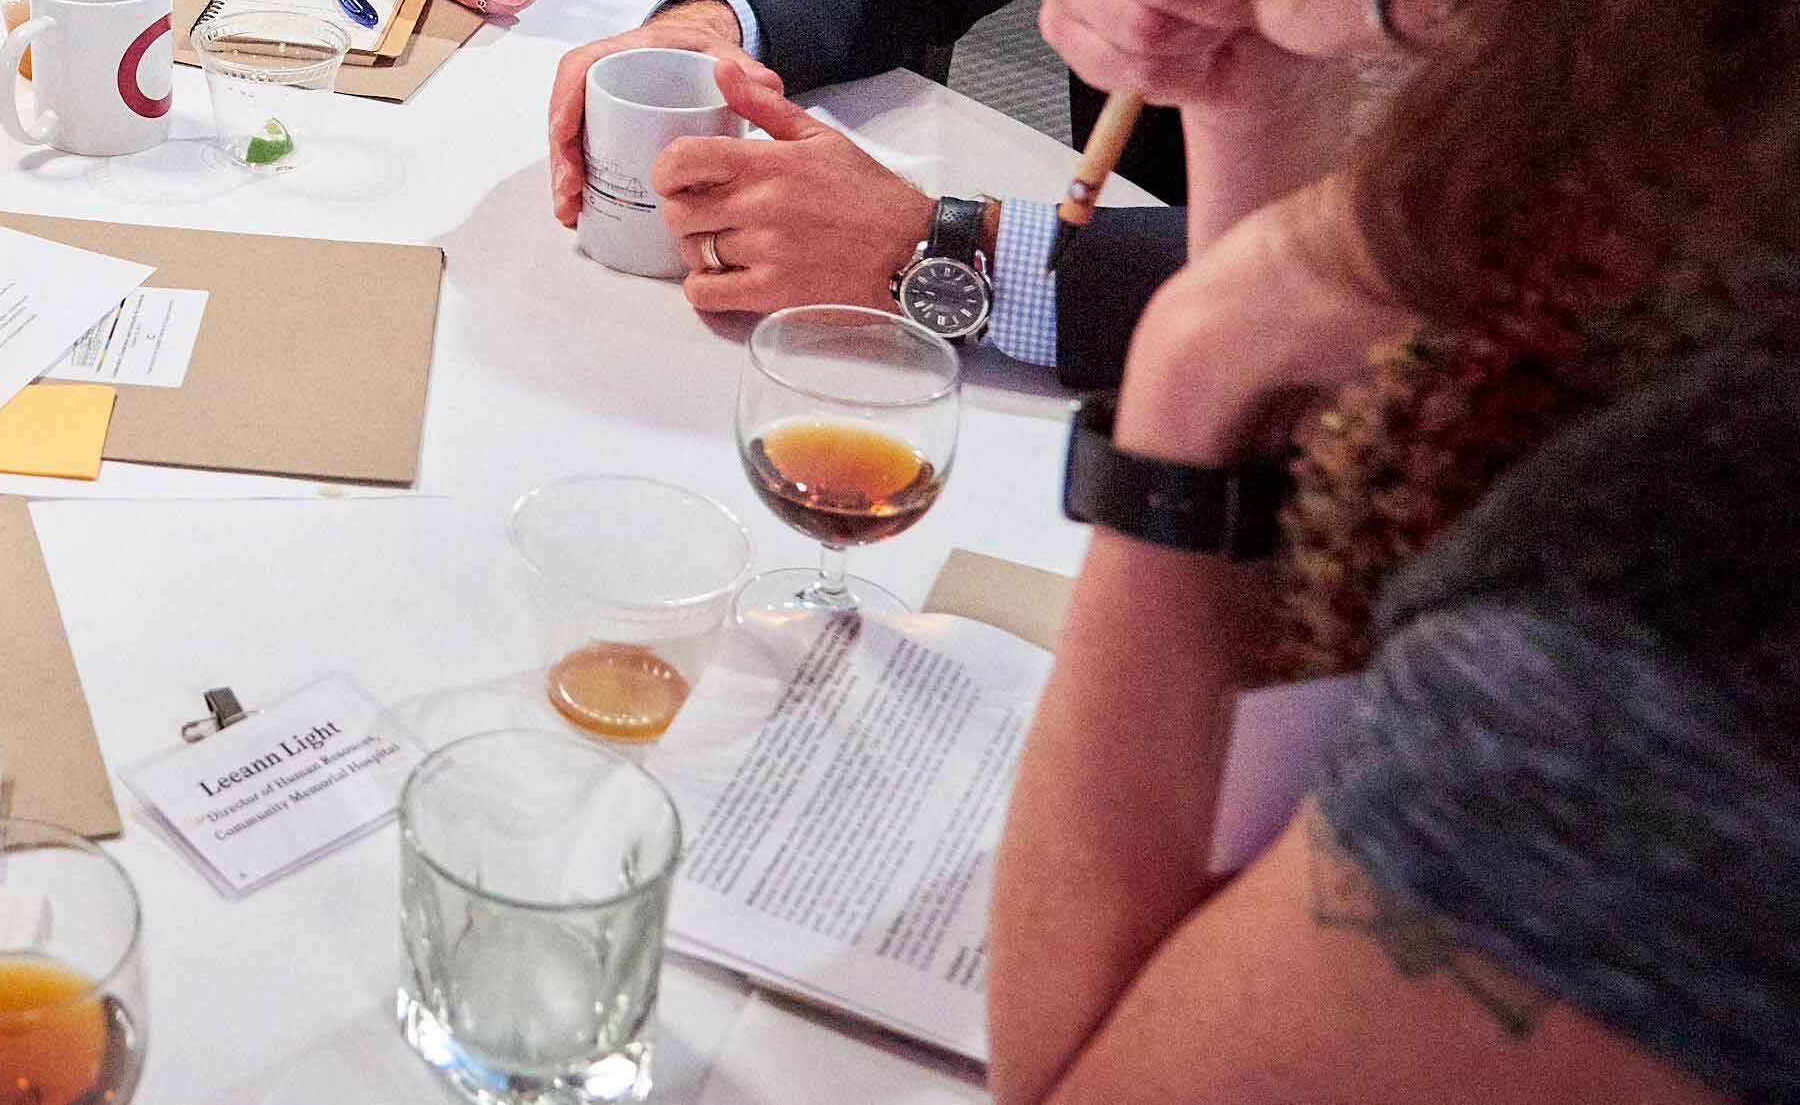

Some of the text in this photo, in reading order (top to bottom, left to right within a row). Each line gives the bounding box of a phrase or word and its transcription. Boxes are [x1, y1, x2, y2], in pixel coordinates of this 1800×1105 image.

[199, 720, 343, 797] Leeann Light
[206, 792, 260, 822] Director
[262, 783, 276, 798] of
[275, 761, 322, 789] Human
[213, 743, 400, 841] Community Memorial Hospital
